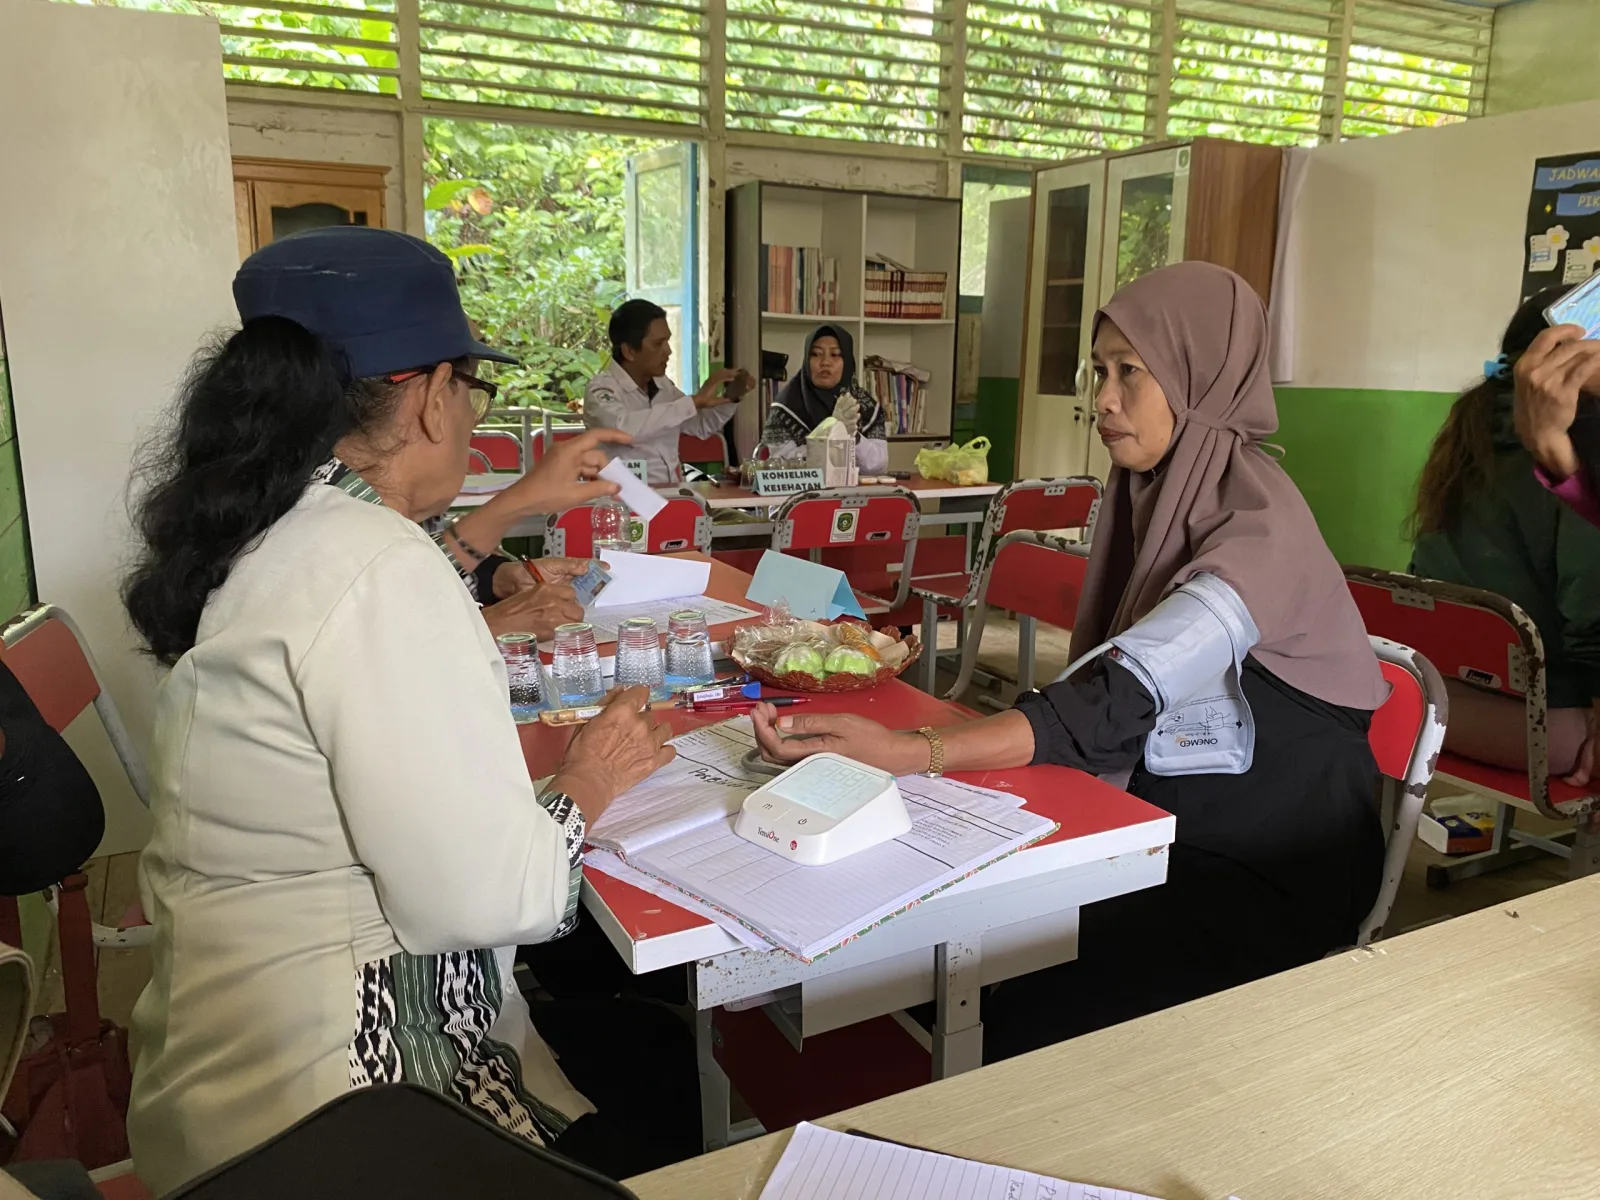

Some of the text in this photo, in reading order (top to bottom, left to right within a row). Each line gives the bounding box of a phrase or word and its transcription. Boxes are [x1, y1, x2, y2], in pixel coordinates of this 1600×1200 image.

[1549, 167, 1600, 182] JADWA
[761, 470, 819, 480] KONSELING
[763, 482, 822, 492] KESEHATAN
[1180, 738, 1218, 748] ONEMED
